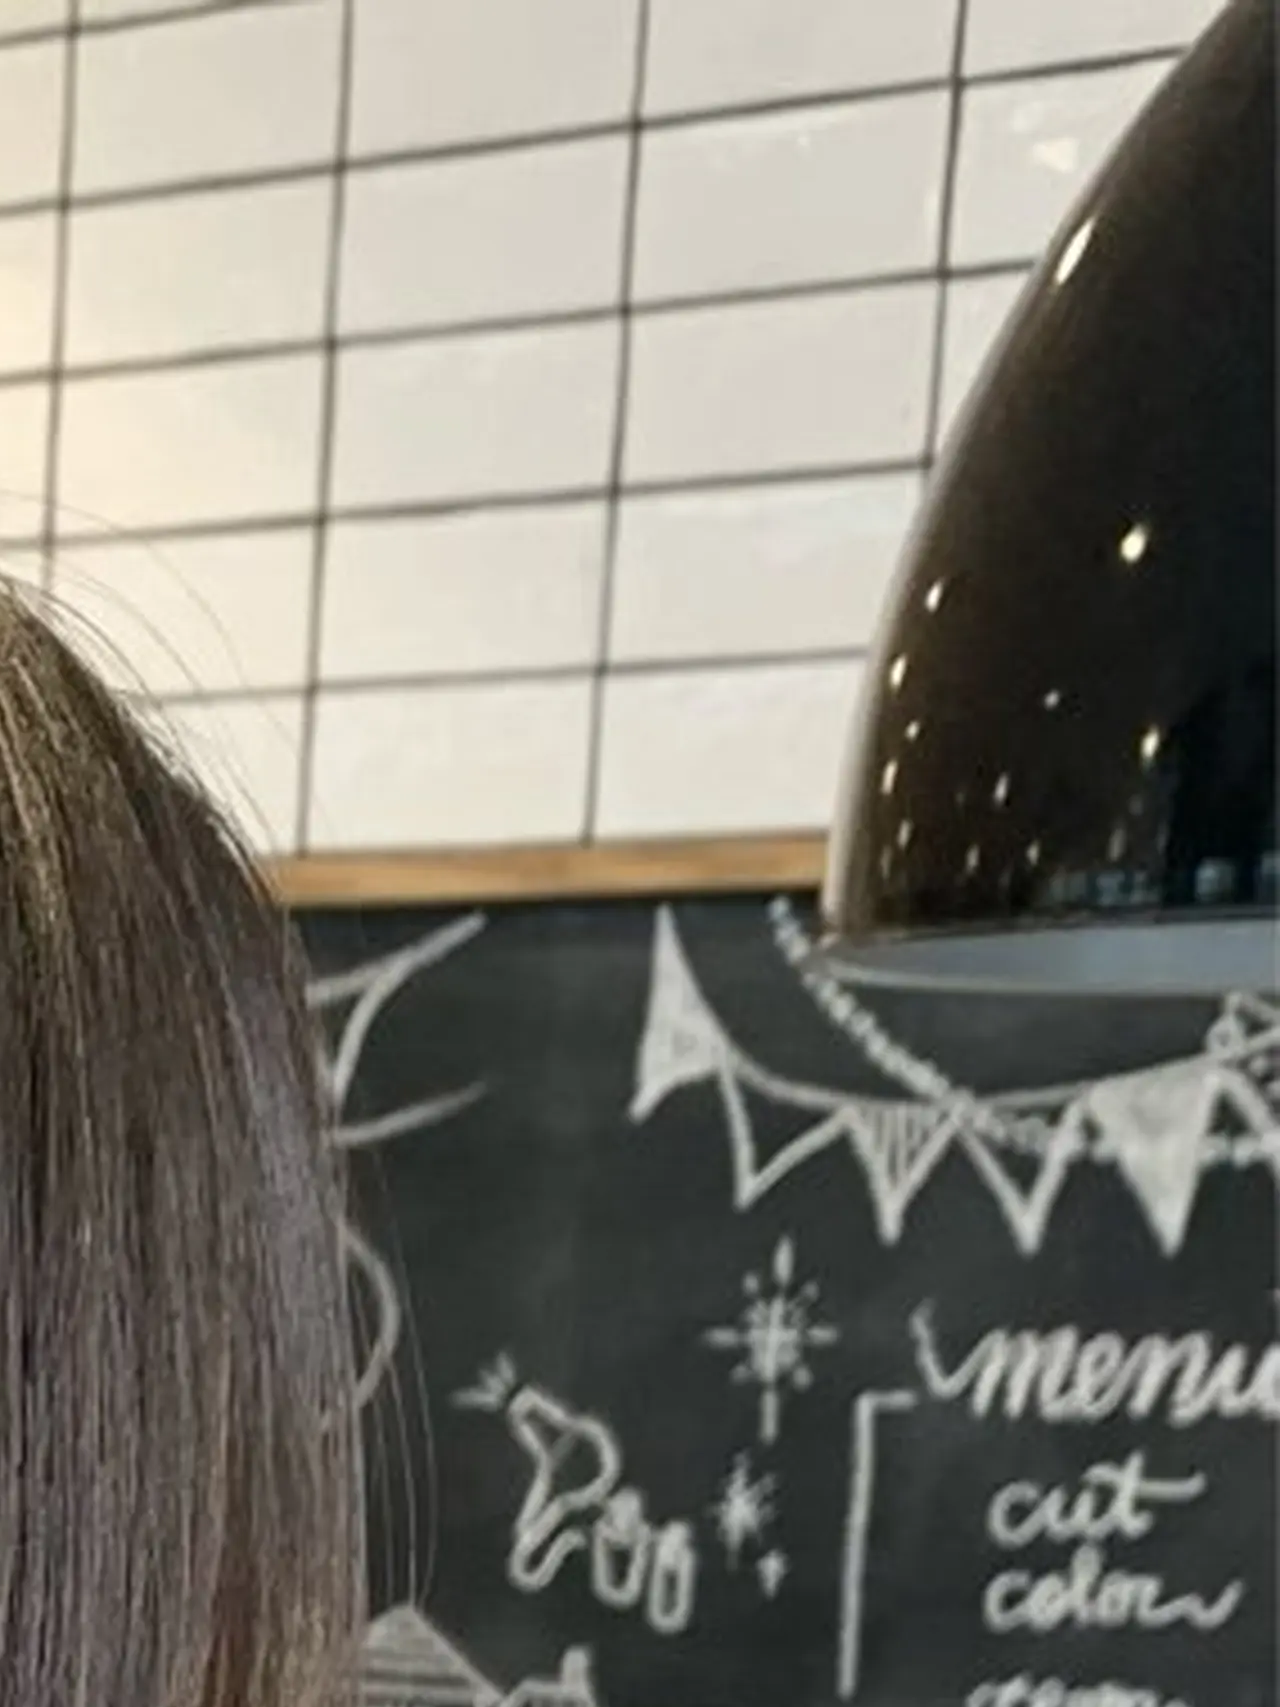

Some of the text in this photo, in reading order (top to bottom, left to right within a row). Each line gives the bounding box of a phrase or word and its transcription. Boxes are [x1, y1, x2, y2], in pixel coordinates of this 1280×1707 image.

[911, 1301, 1280, 1427] menu
[987, 1452, 1206, 1547] cut
[984, 1545, 1243, 1630] color
